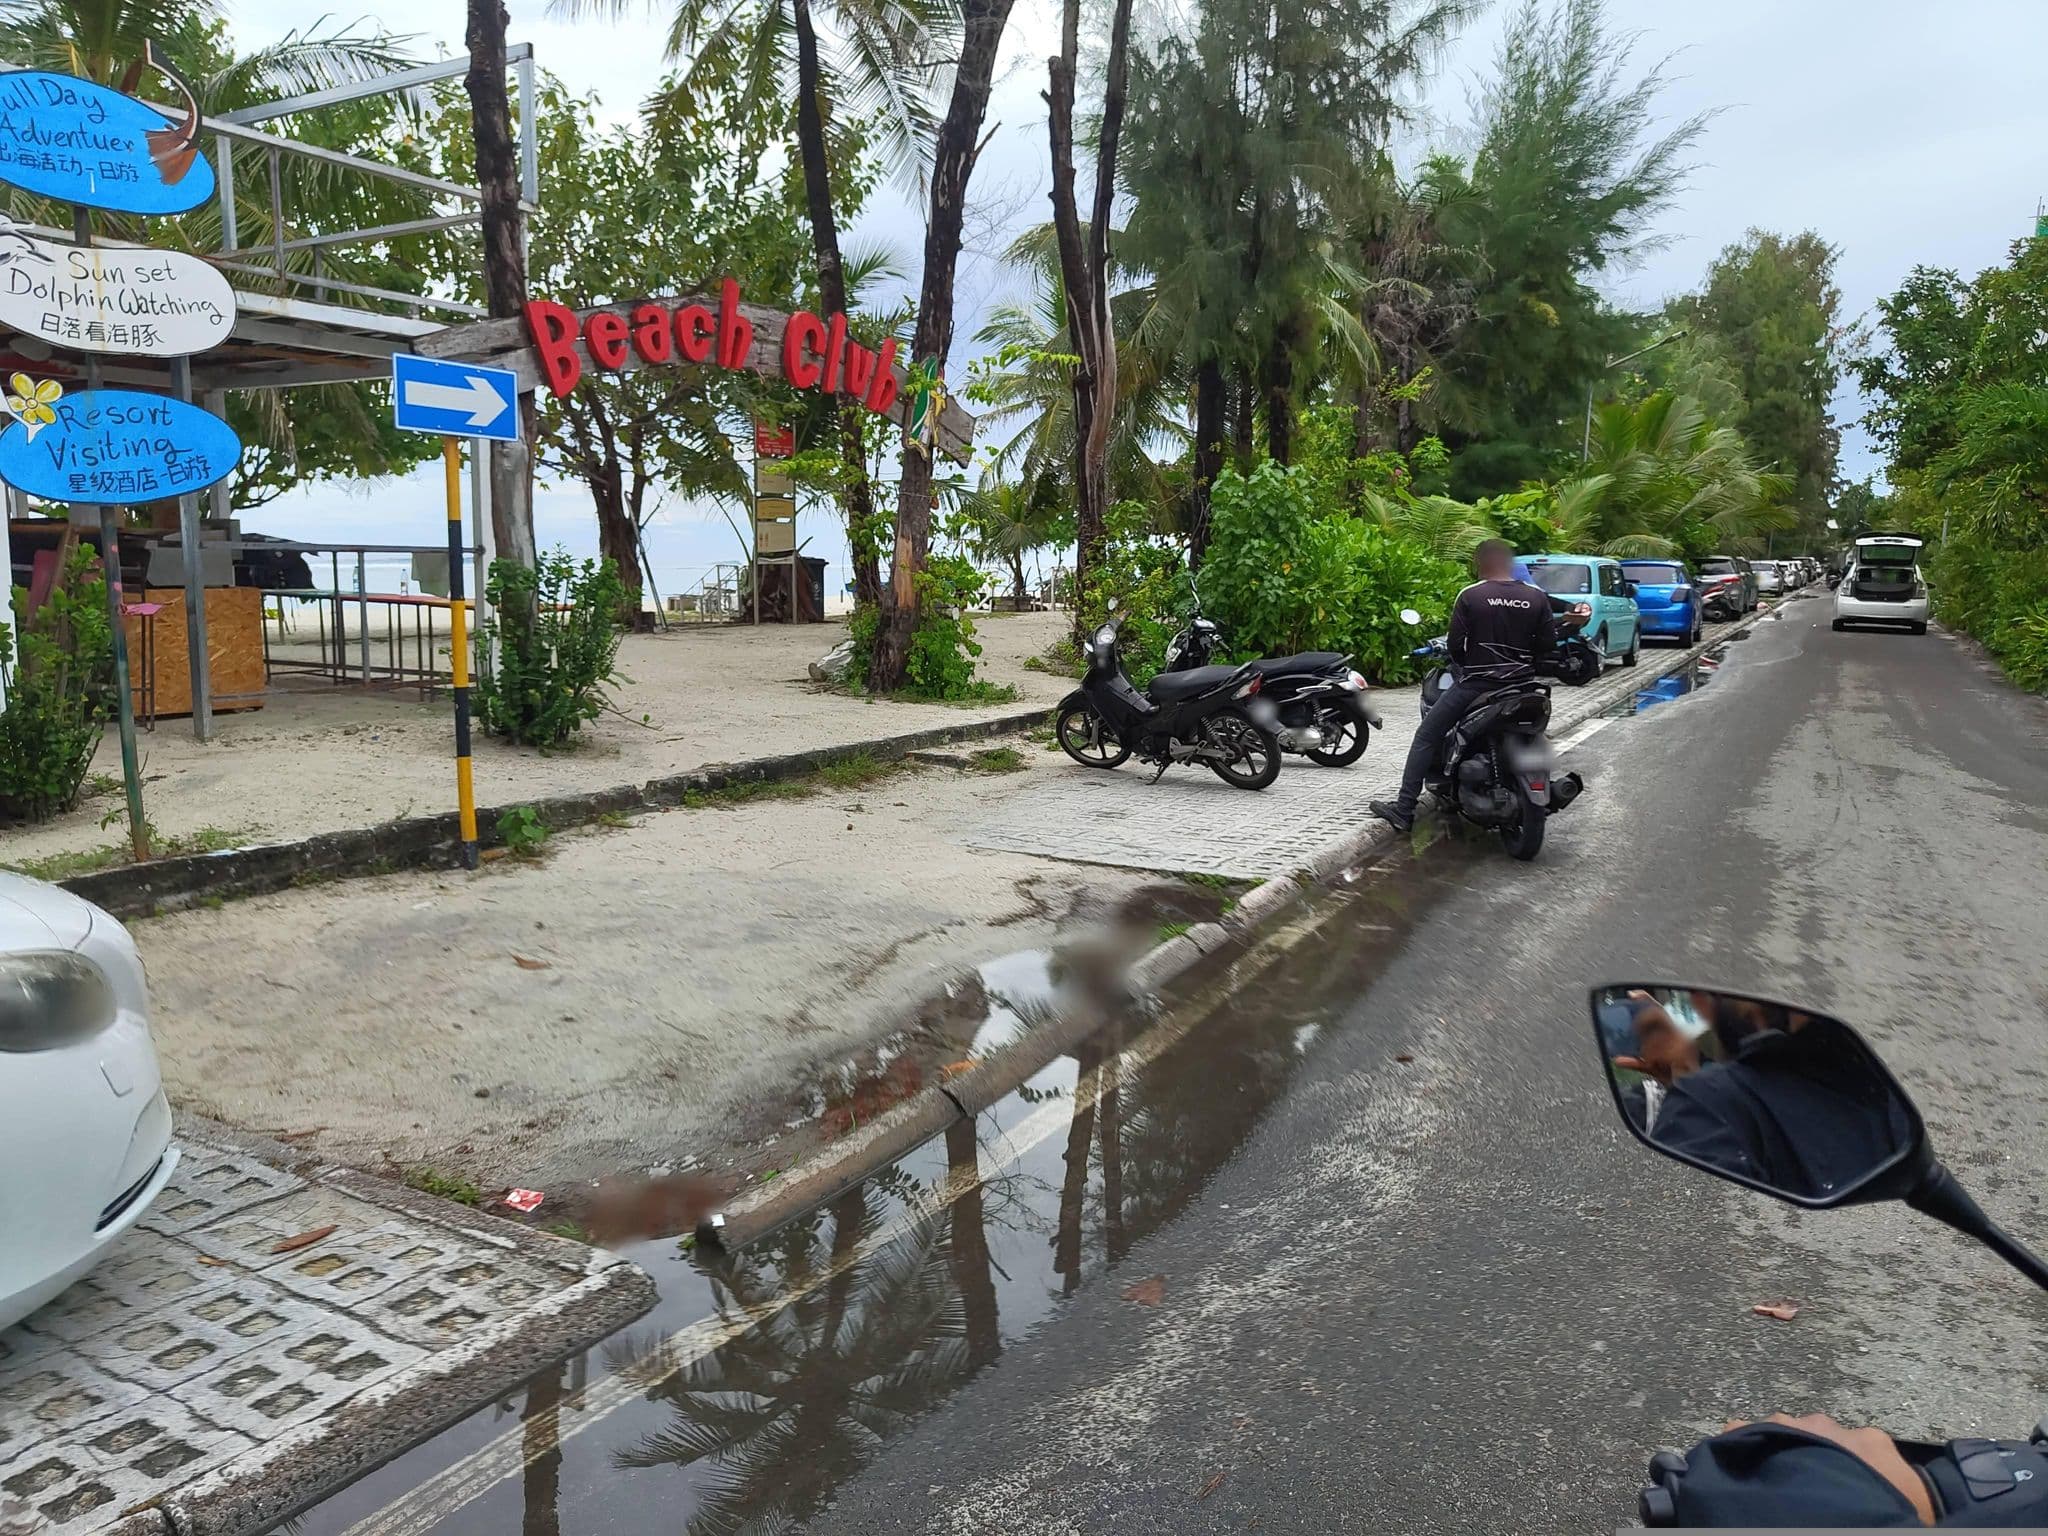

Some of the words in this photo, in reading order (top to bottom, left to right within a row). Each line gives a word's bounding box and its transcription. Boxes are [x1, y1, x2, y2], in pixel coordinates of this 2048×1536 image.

[0, 78, 40, 111] ull
[39, 79, 108, 124] Day
[0, 111, 135, 152] Adventuer
[68, 251, 125, 284] Sun
[138, 260, 176, 282] set
[5, 267, 114, 311] Dolphin
[118, 288, 225, 326] Watching
[41, 312, 164, 347] 日落看海豚
[524, 277, 754, 399] Beach
[783, 311, 897, 413] Club
[57, 400, 172, 432] Resort
[45, 431, 192, 470] Visiting
[1487, 598, 1530, 608] WAMCO
